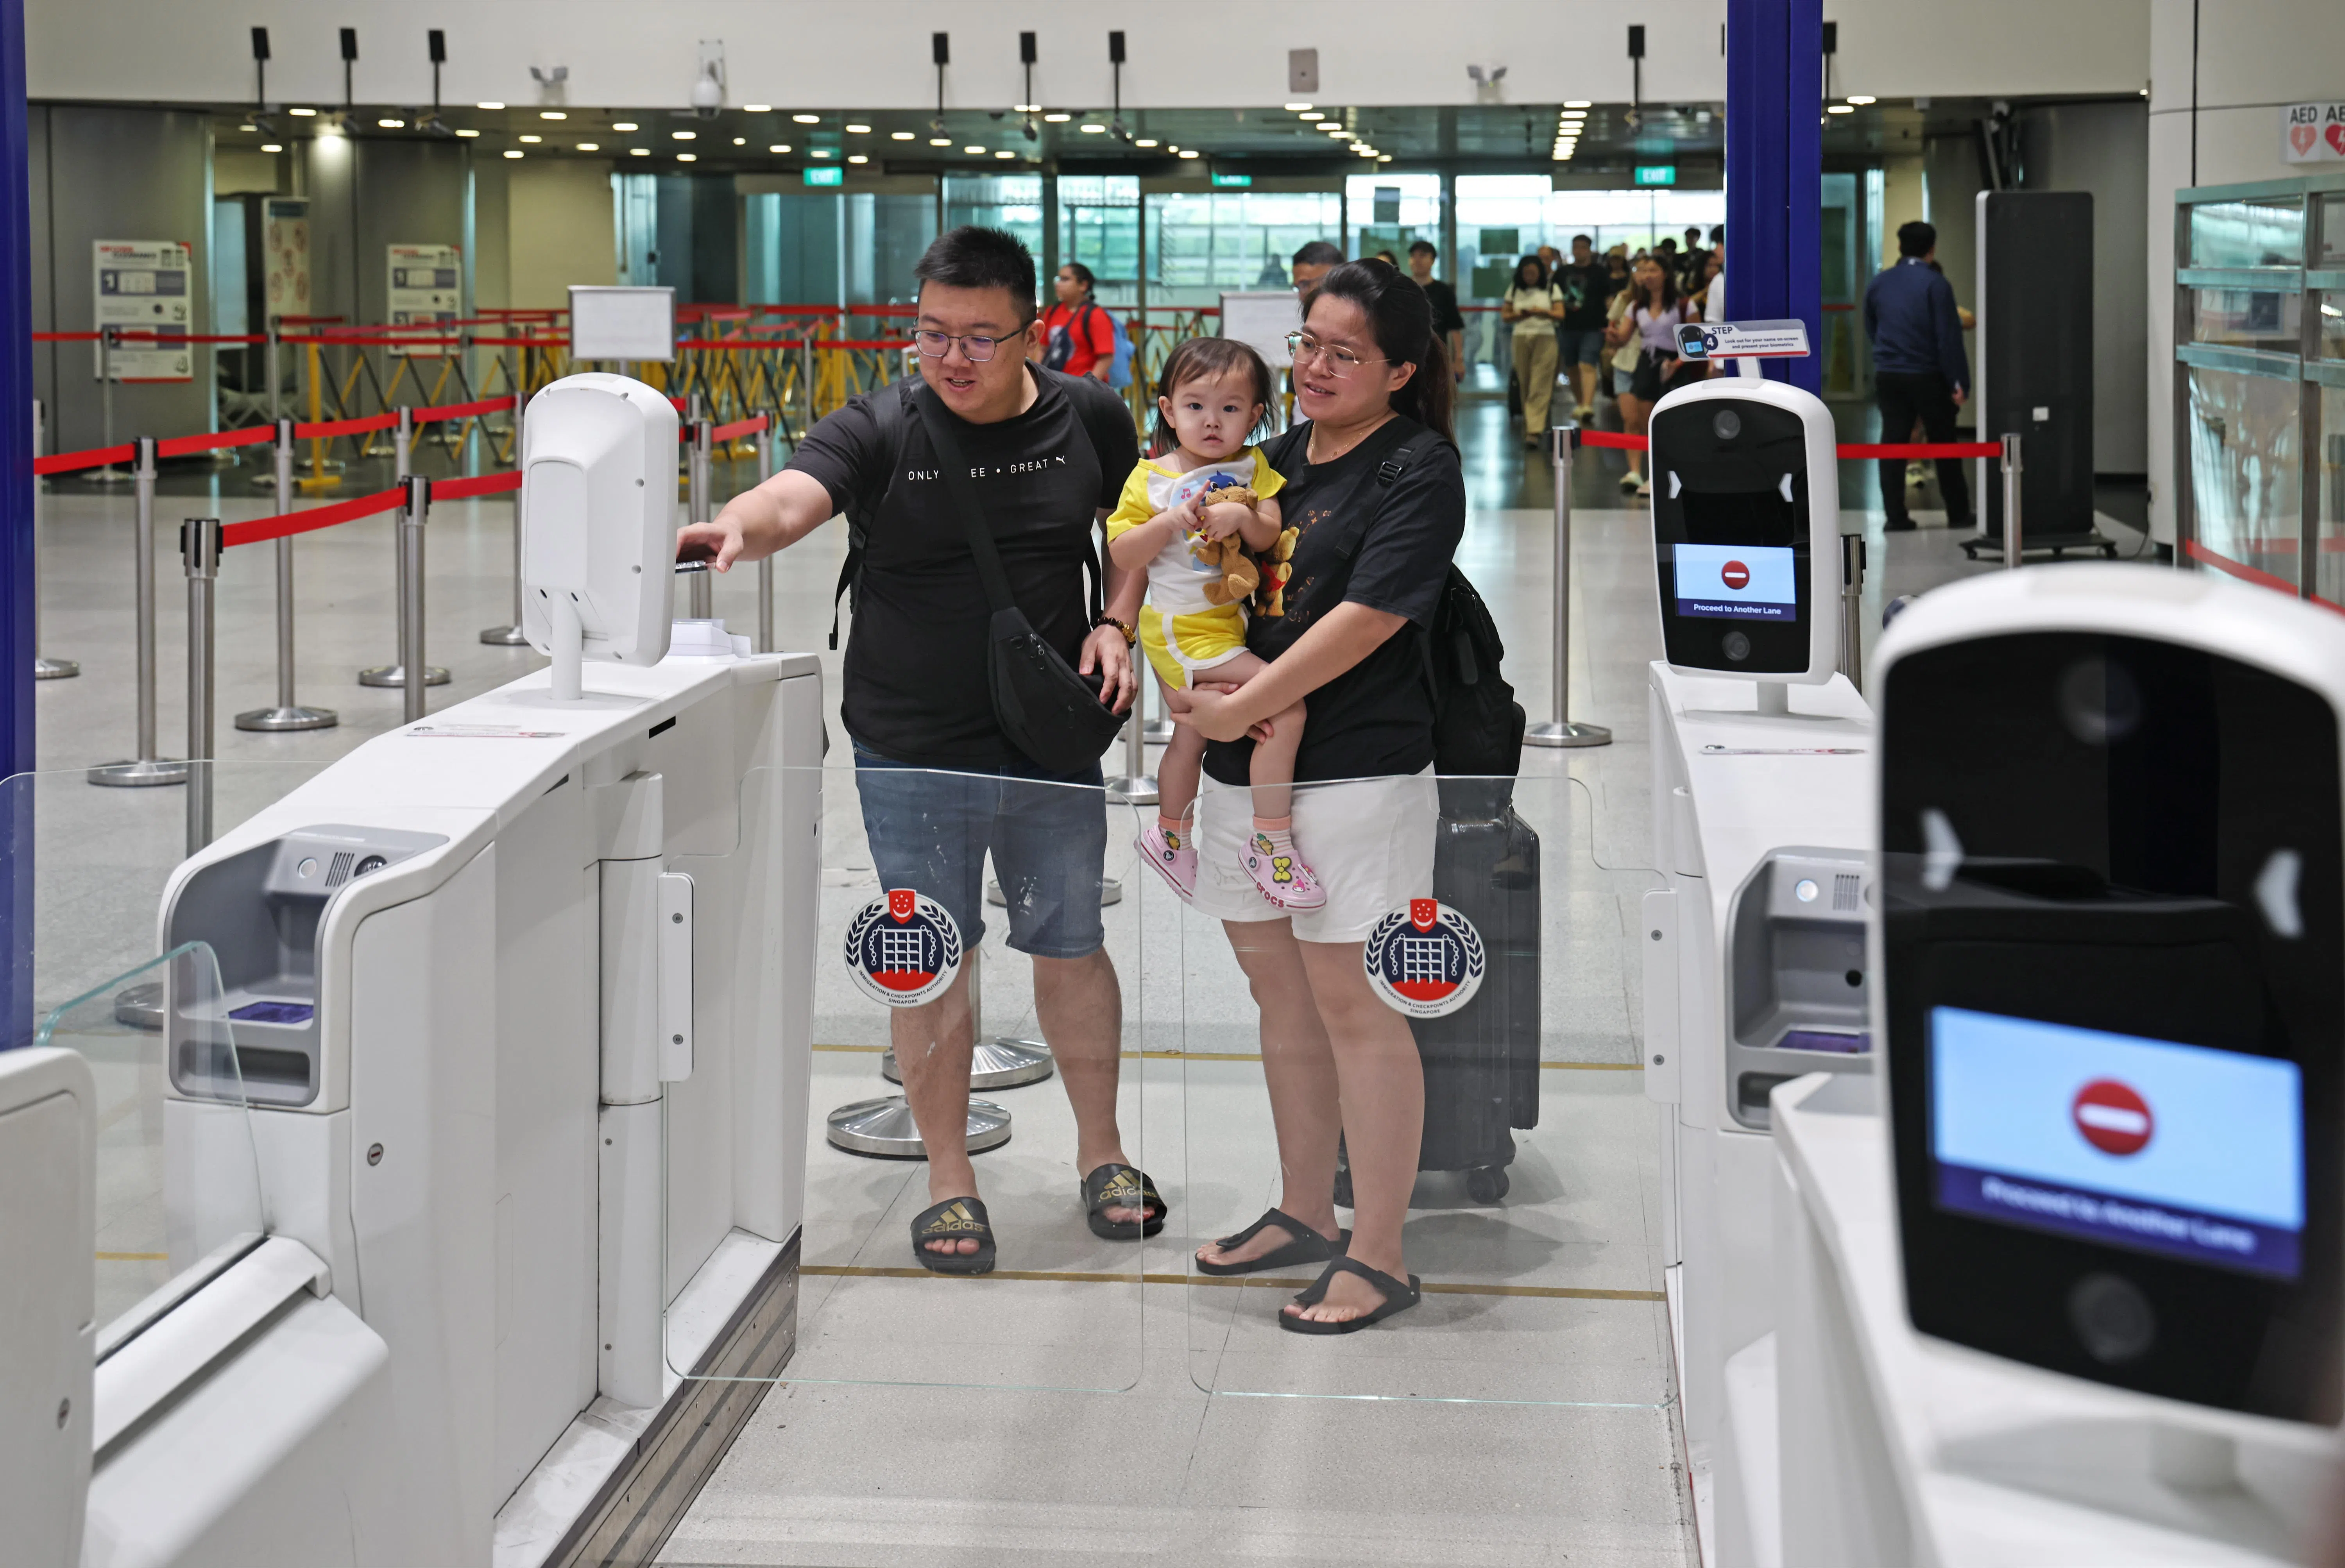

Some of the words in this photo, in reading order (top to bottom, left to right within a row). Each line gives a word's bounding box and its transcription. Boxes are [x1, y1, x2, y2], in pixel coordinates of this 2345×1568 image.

[2290, 106, 2318, 123] AED
[1707, 337, 1714, 346] 4
[908, 470, 940, 480] ONLY
[971, 467, 986, 478] EE
[1010, 458, 1048, 474] GREAT
[1693, 603, 1723, 612] Proceed
[1257, 881, 1284, 908] crocs
[859, 970, 886, 995] IMMIGRATION
[891, 990, 926, 999] CHECKPOINTS
[927, 971, 947, 992] AUTHORITY
[1379, 979, 1407, 1005] IMMIGRATION
[1412, 1001, 1448, 1009] CHECKPOINTS
[1449, 980, 1471, 1002] AUTHORITY
[1100, 1186, 1157, 1200] adidas
[922, 1219, 985, 1233] adidas
